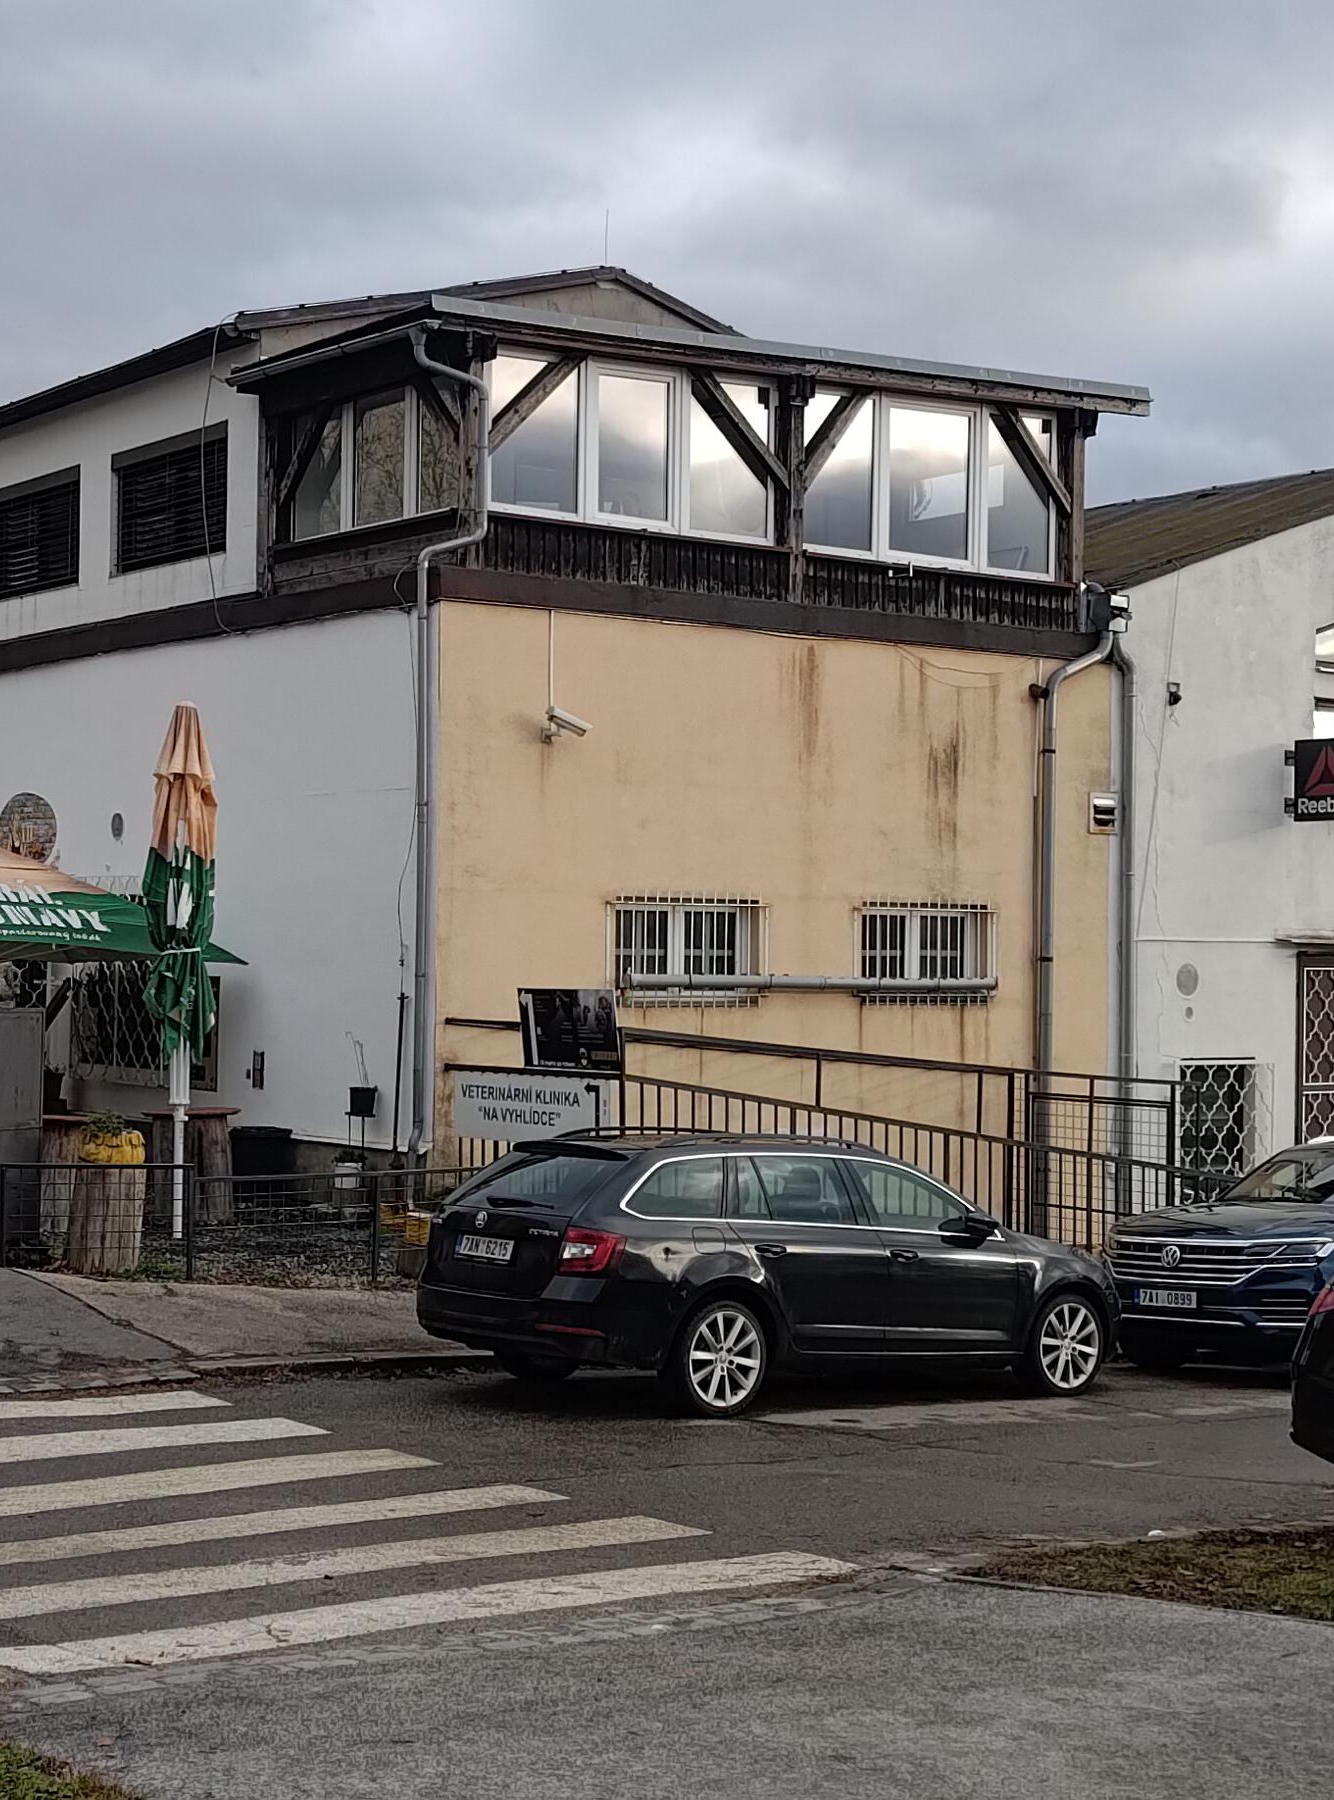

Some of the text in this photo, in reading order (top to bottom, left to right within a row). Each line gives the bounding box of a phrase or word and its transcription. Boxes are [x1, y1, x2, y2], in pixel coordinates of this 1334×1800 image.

[461, 1083, 532, 1103] VETERINÁRNÍ
[535, 1088, 580, 1108] KLINIKA
[463, 1235, 508, 1257] 7AN 6215
[1167, 1292, 1192, 1306] 0899
